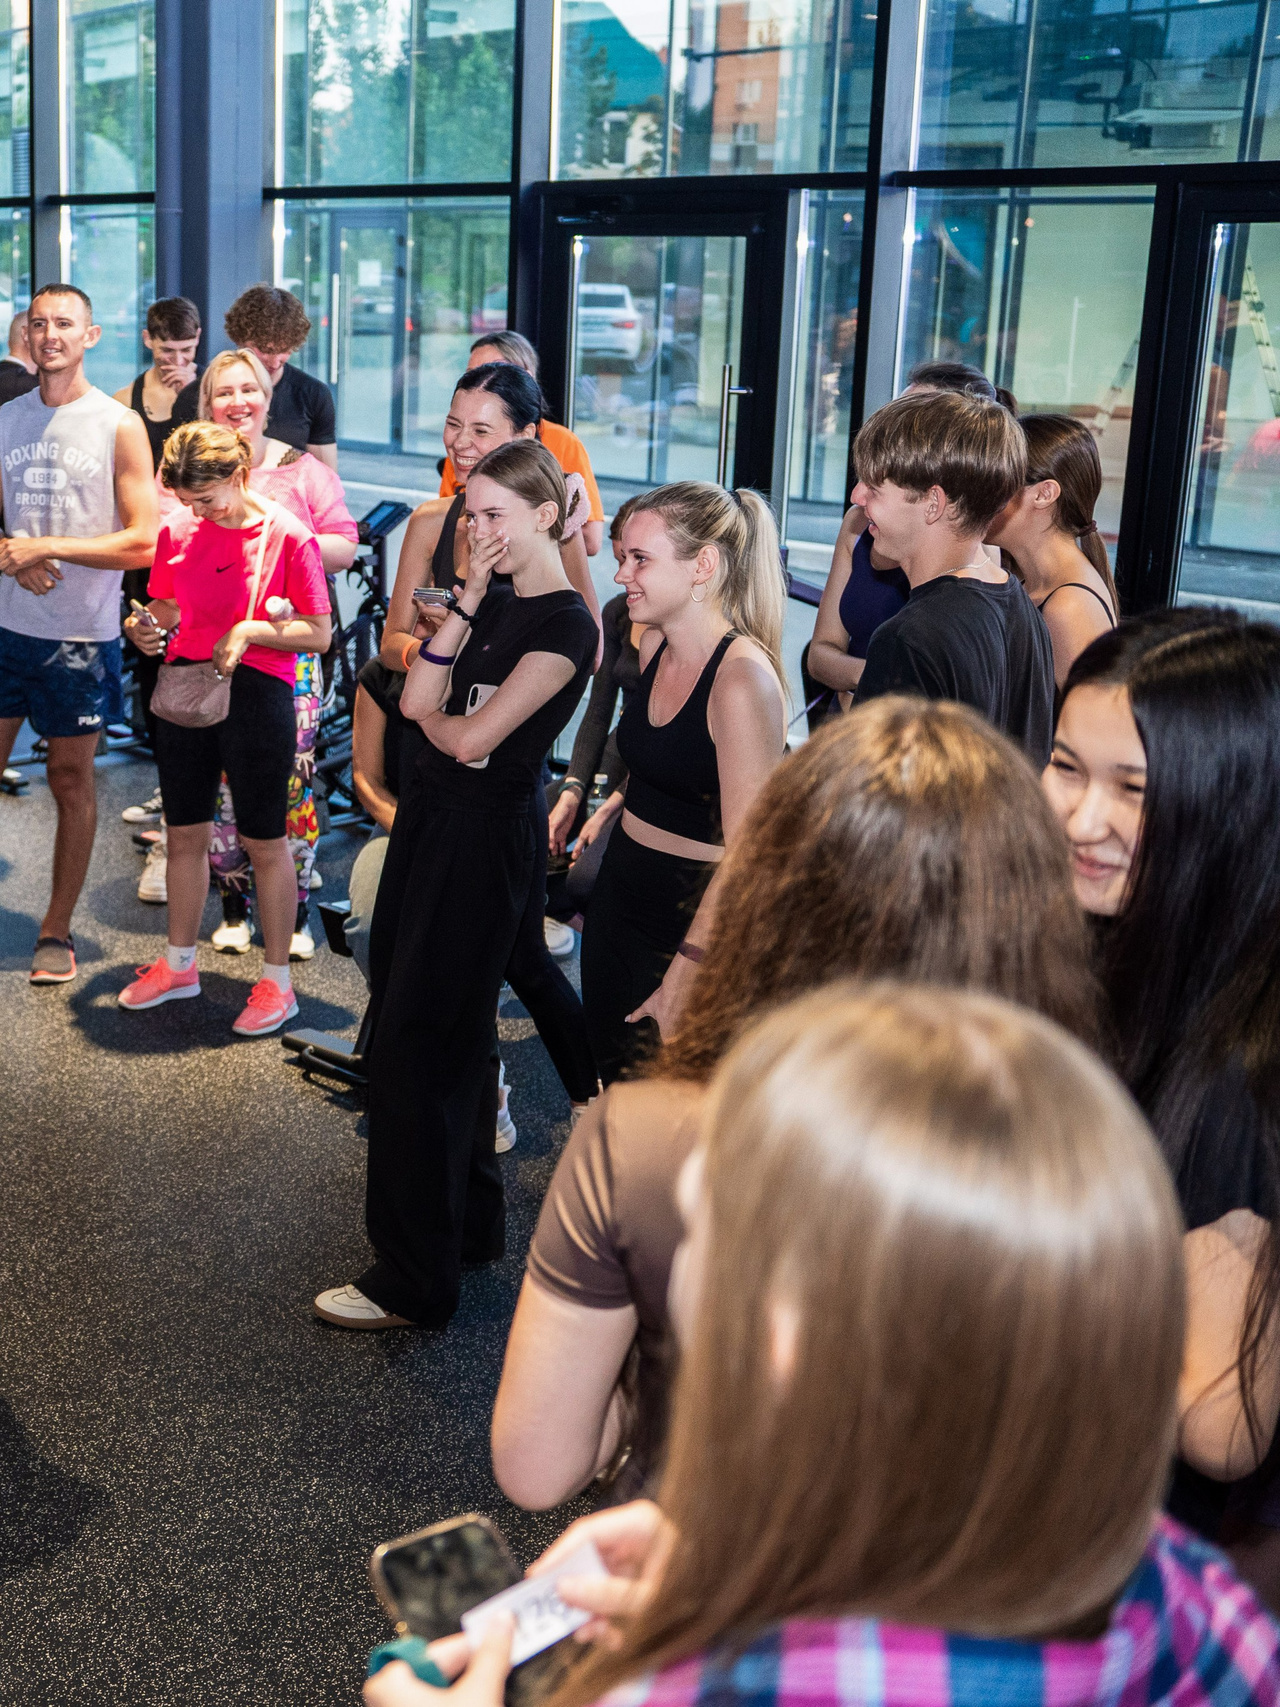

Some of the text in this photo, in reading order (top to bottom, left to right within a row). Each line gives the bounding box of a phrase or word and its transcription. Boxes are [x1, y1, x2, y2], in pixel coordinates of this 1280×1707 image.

[4, 441, 102, 478] BOXING GYM
[15, 492, 76, 508] BROOLYN
